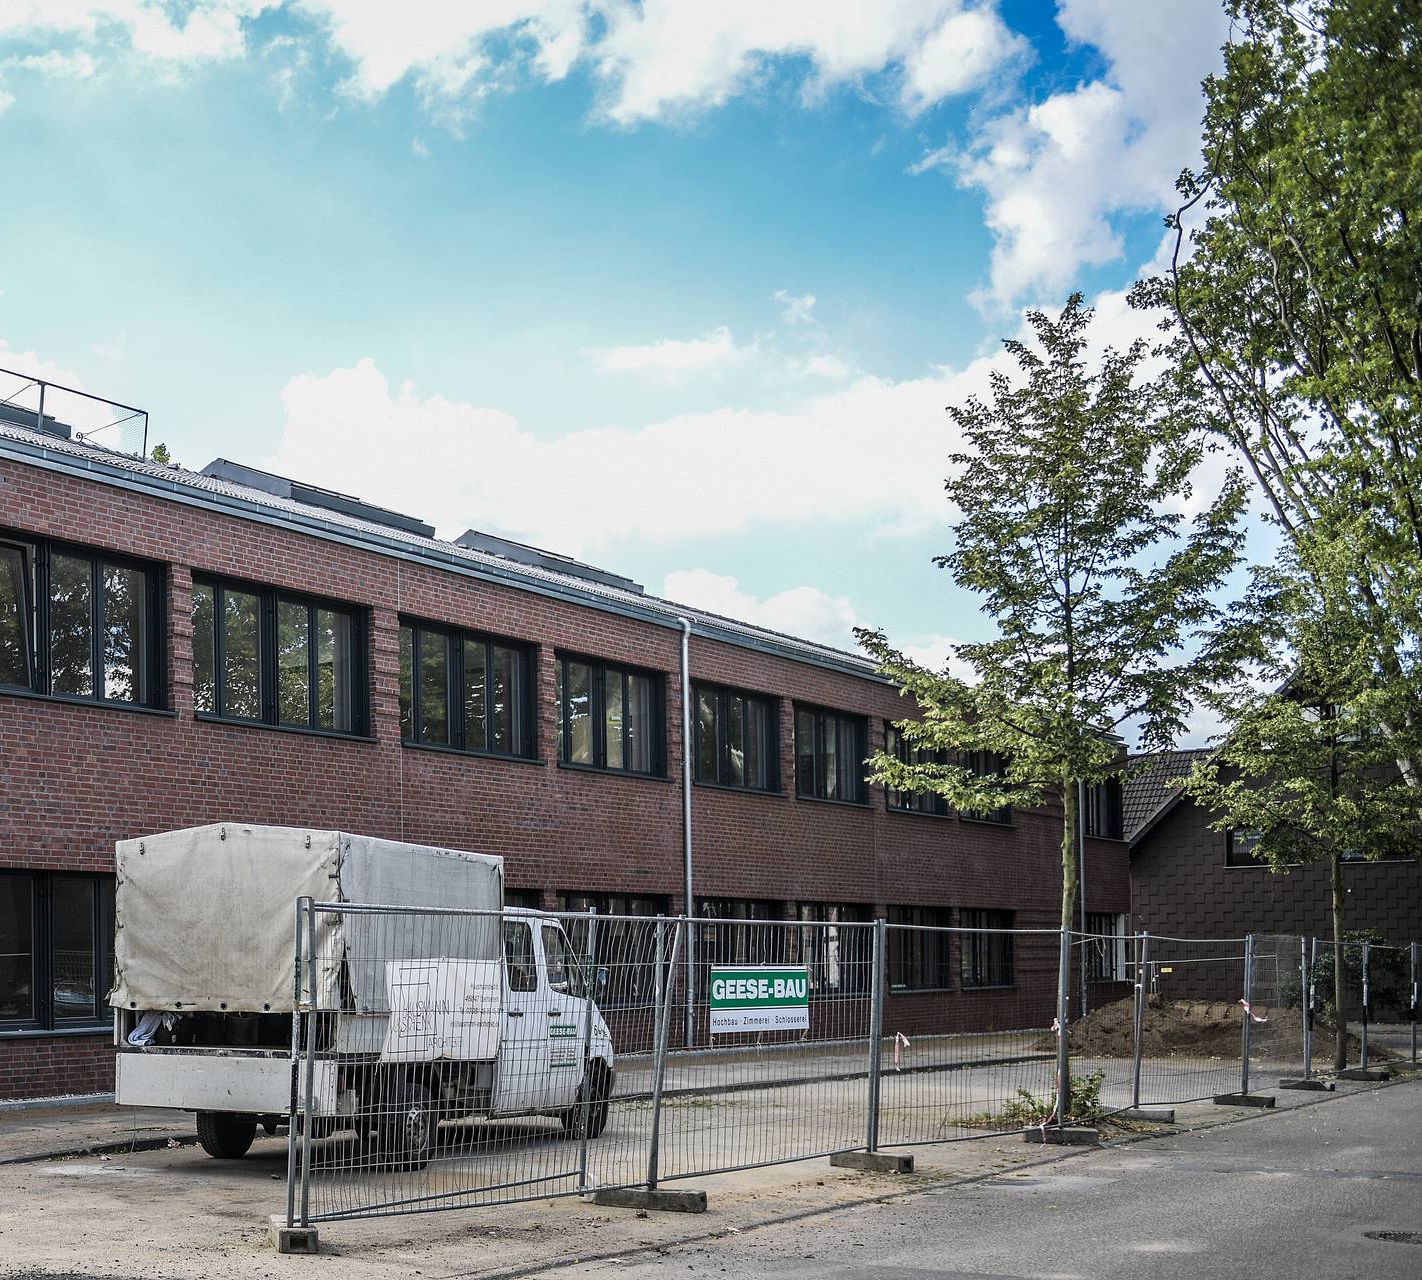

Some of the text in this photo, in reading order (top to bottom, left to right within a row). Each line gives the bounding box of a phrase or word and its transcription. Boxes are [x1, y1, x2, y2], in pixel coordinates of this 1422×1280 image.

[712, 979, 807, 1000] GEESE-BAU
[712, 1015, 807, 1026] Hochbau Zimmerei Schlosserei
